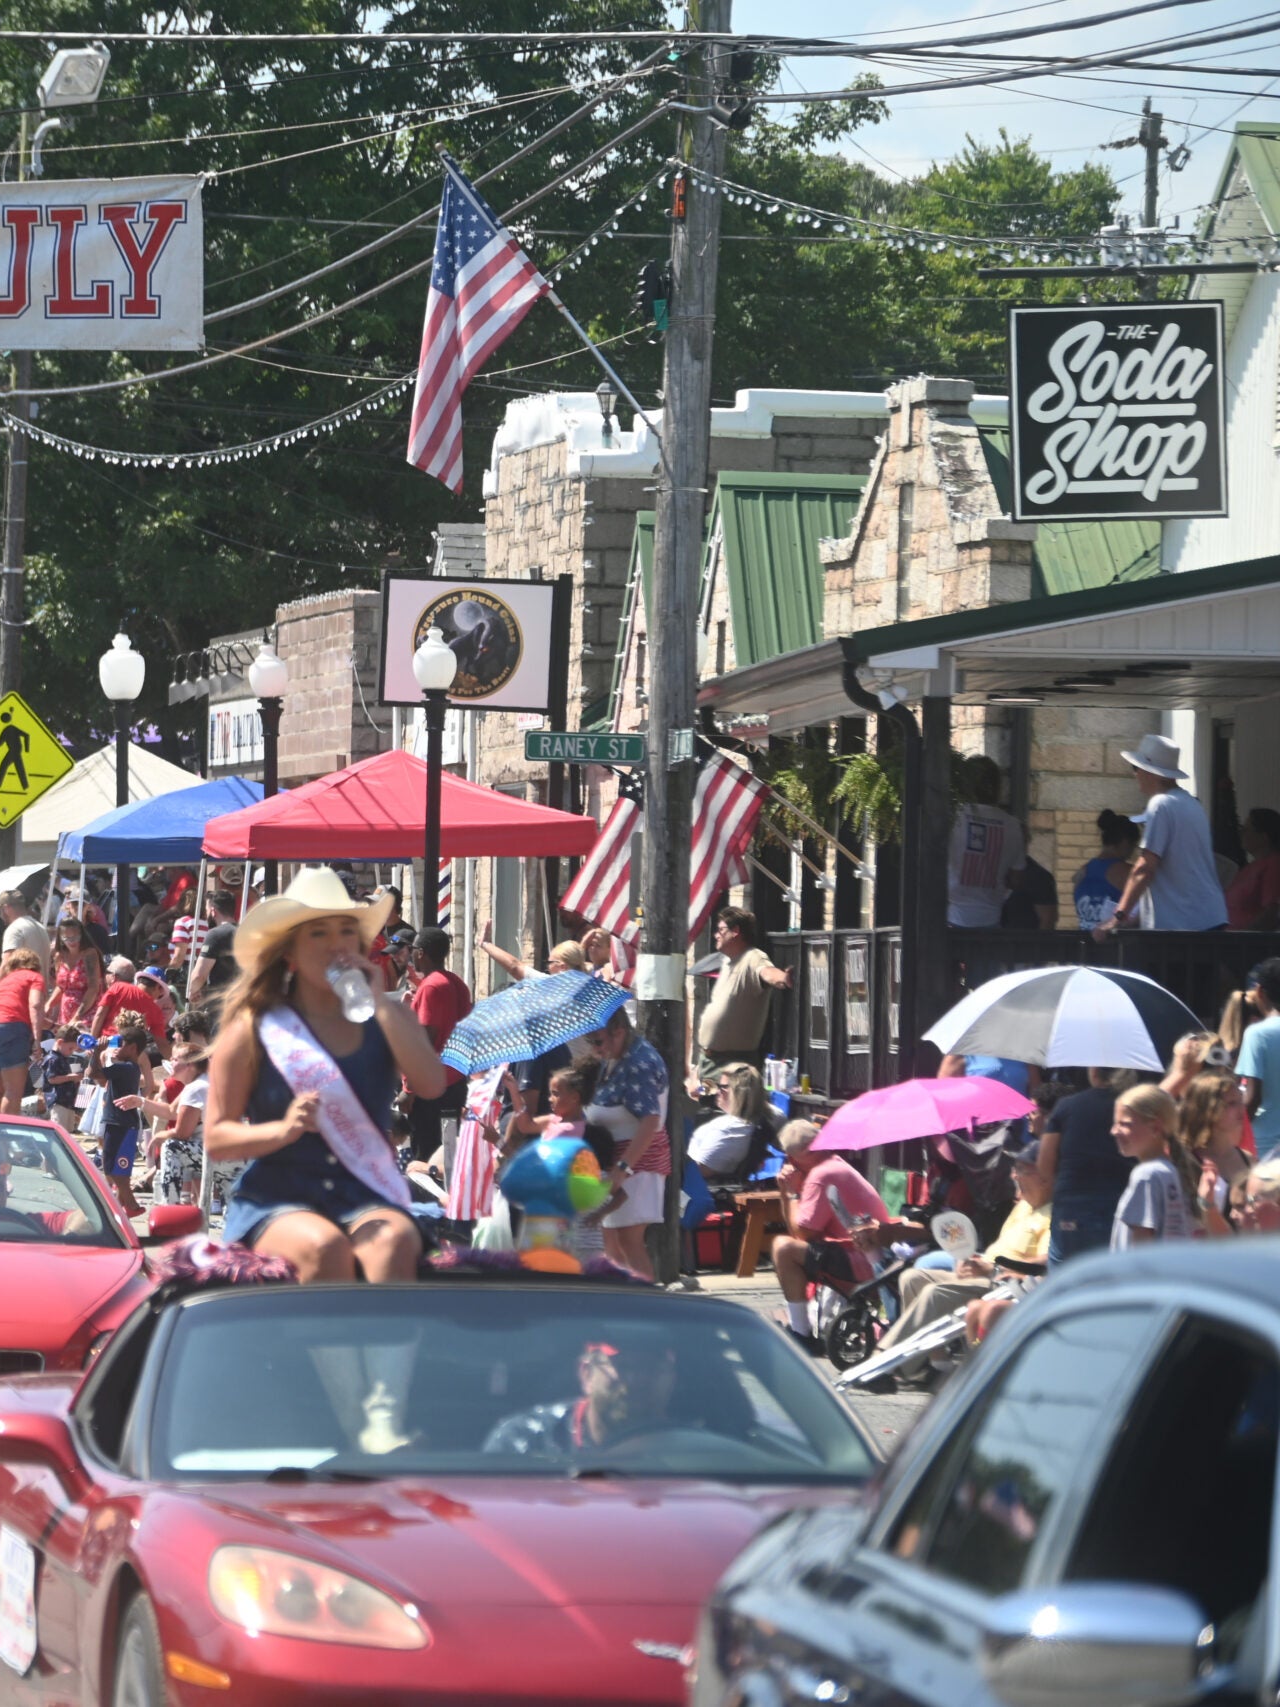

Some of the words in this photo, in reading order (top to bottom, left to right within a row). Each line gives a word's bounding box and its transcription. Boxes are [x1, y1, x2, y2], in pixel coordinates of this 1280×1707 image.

[1116, 324, 1152, 340] THE
[1027, 320, 1214, 424] Soda
[1025, 402, 1208, 505] Shop
[539, 736, 598, 758] RANEY
[608, 738, 630, 759] ST
